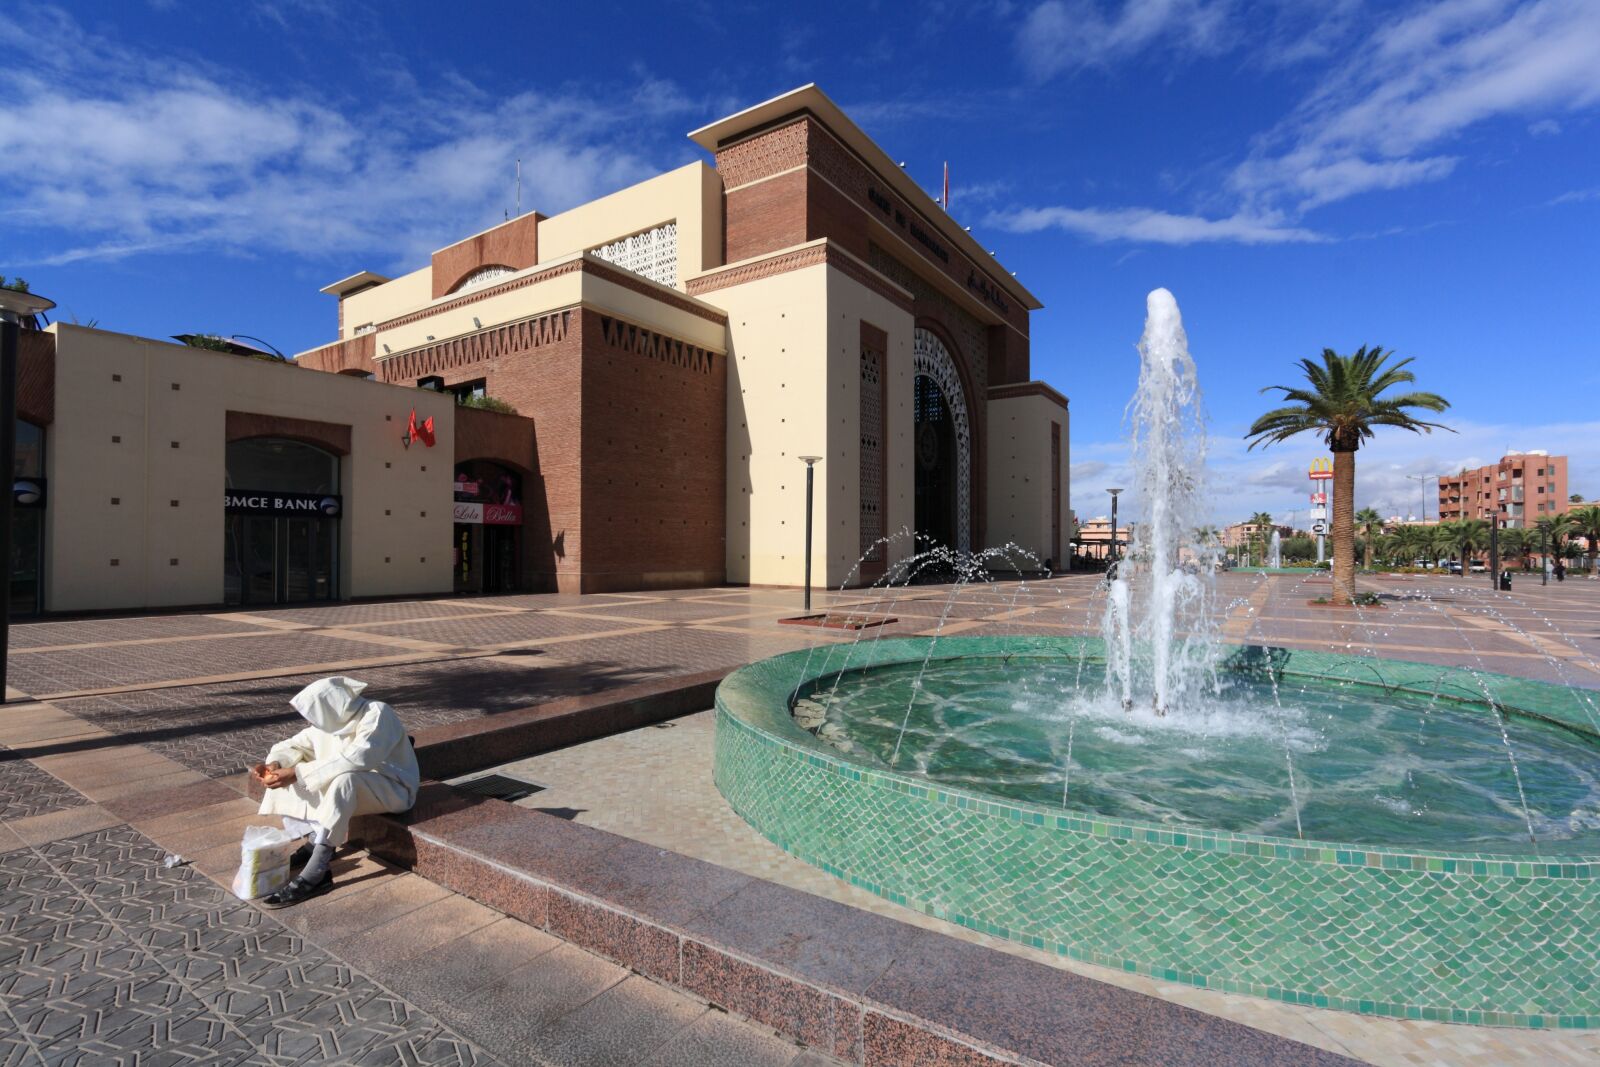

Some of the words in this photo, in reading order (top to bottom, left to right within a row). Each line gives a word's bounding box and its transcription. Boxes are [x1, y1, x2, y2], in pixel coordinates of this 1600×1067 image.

[224, 496, 268, 508] BMCE
[274, 498, 317, 510] BANK
[453, 504, 480, 520] Lola
[486, 506, 517, 521] Bella
